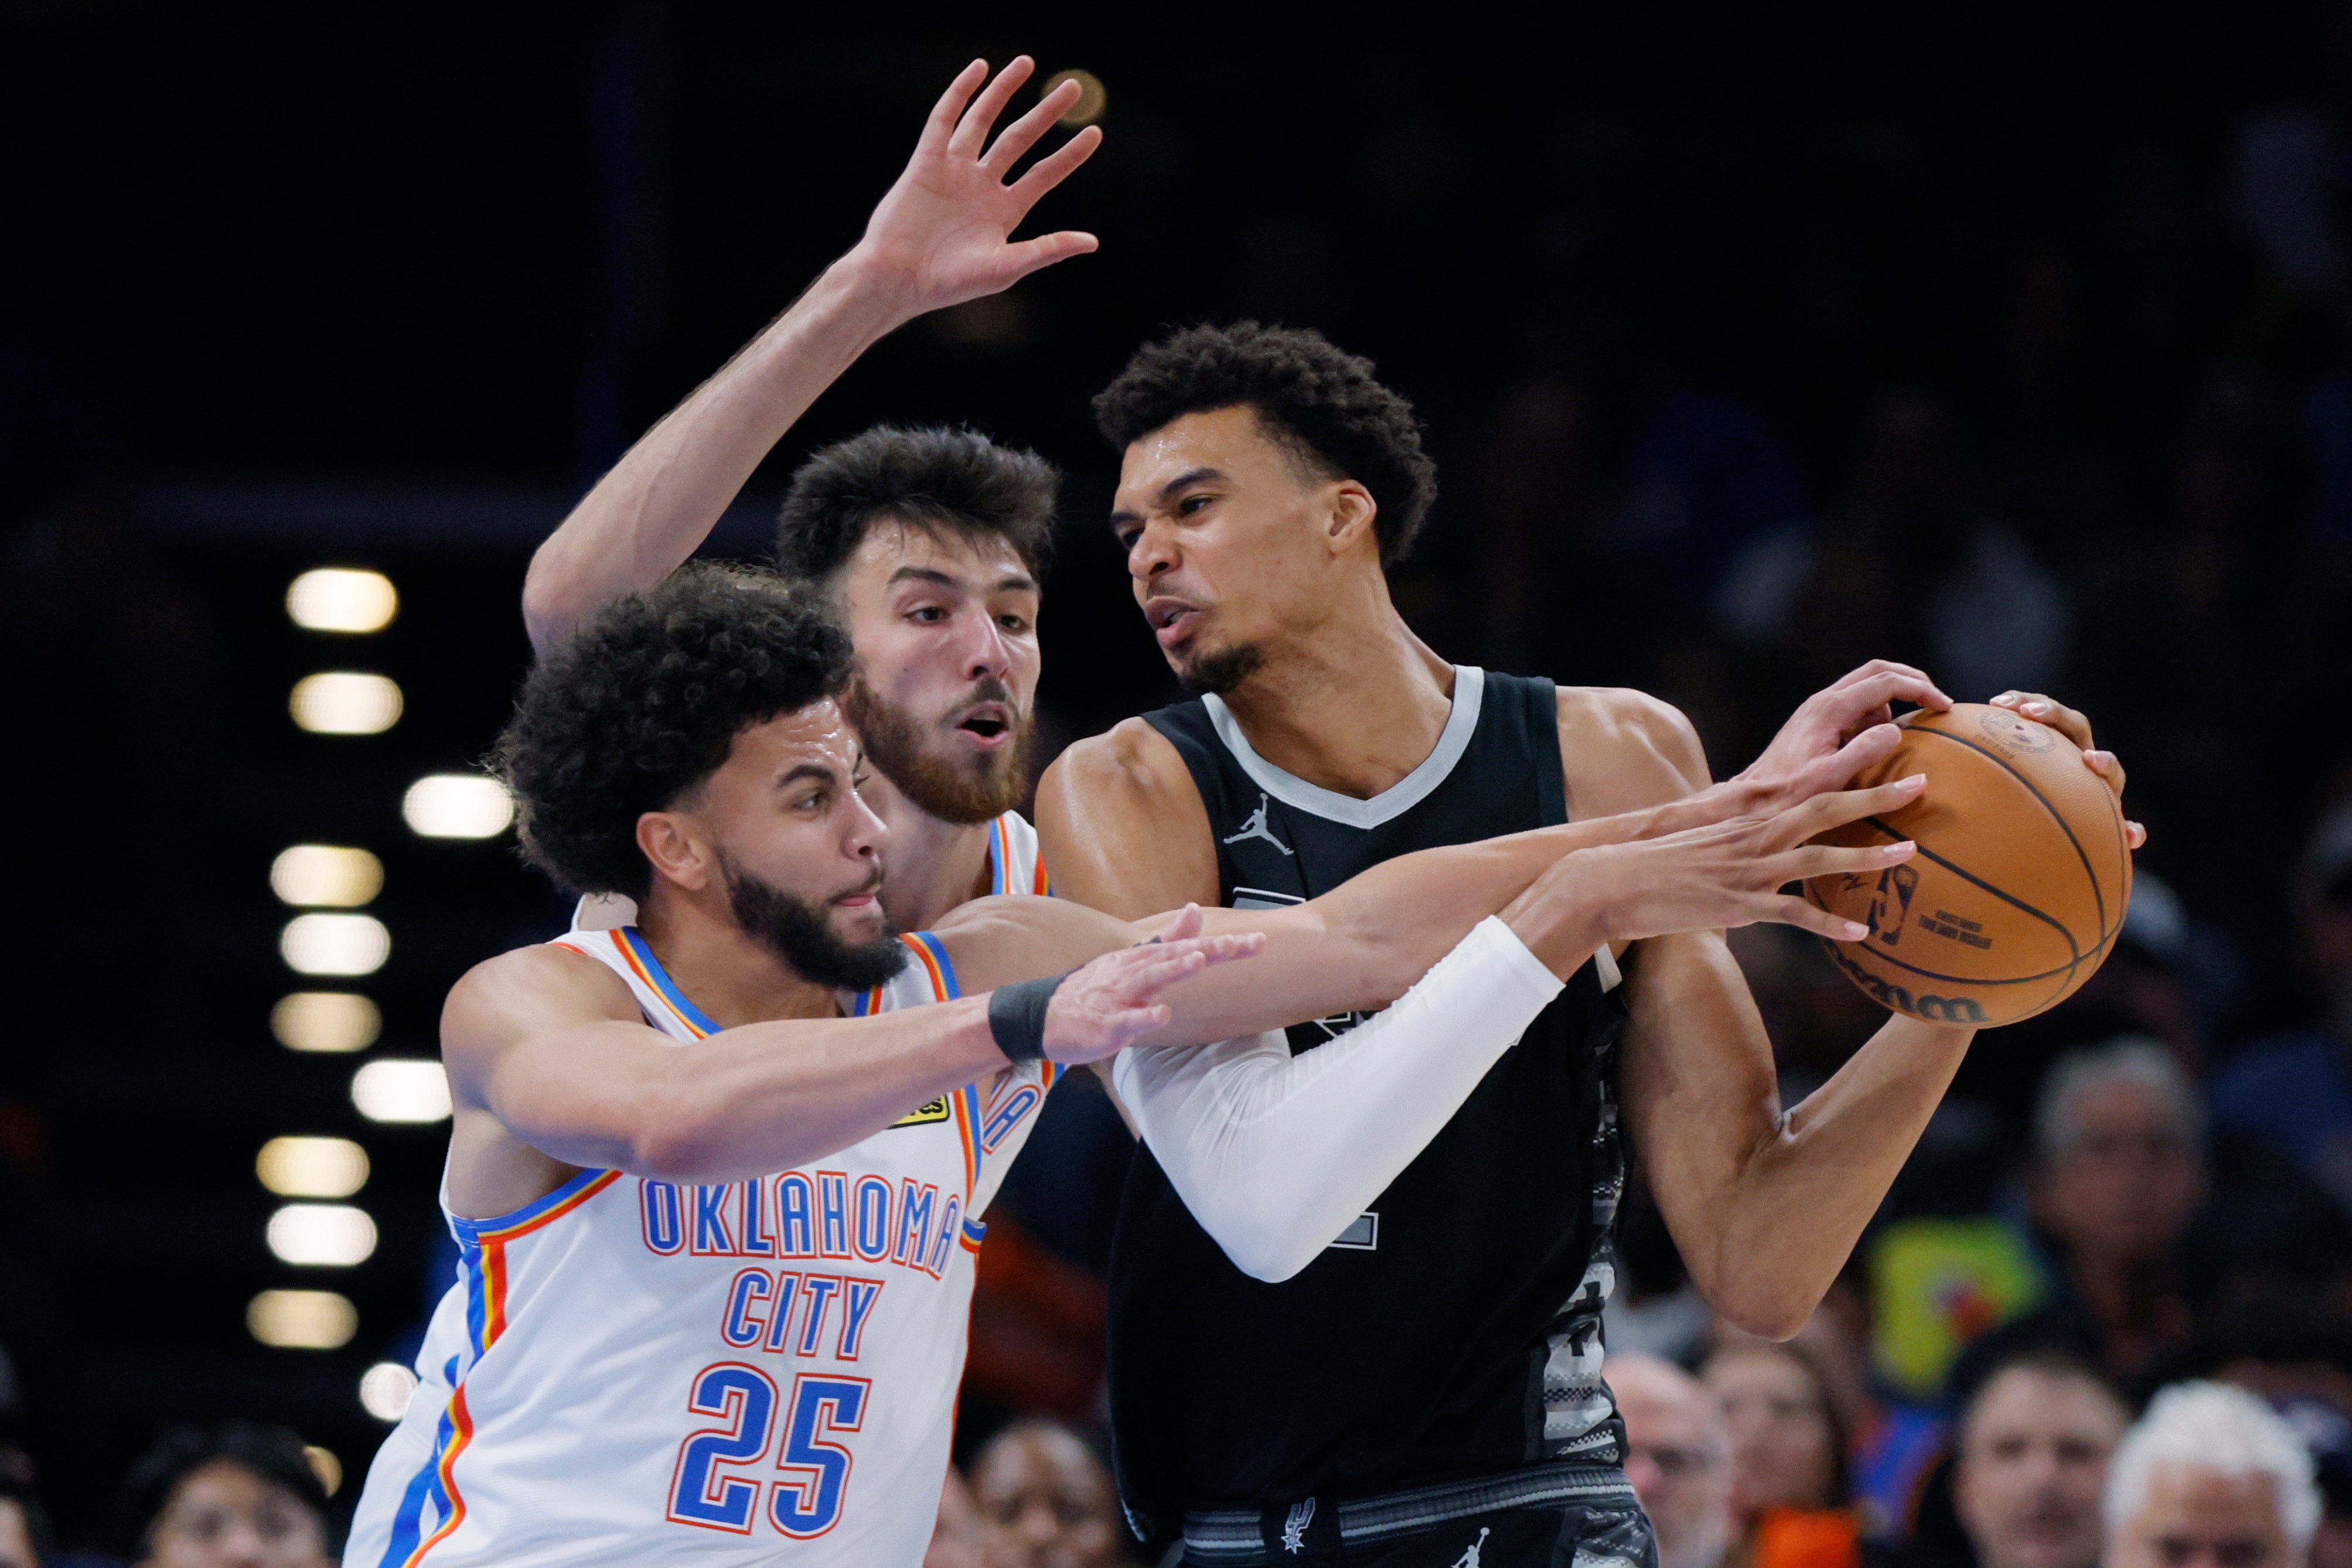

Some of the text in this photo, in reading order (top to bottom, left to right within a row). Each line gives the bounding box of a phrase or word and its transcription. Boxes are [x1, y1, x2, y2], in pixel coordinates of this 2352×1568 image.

[639, 1170, 960, 1280] OKLAHOMA
[721, 1267, 884, 1361] CITY
[666, 1361, 872, 1540] 25
